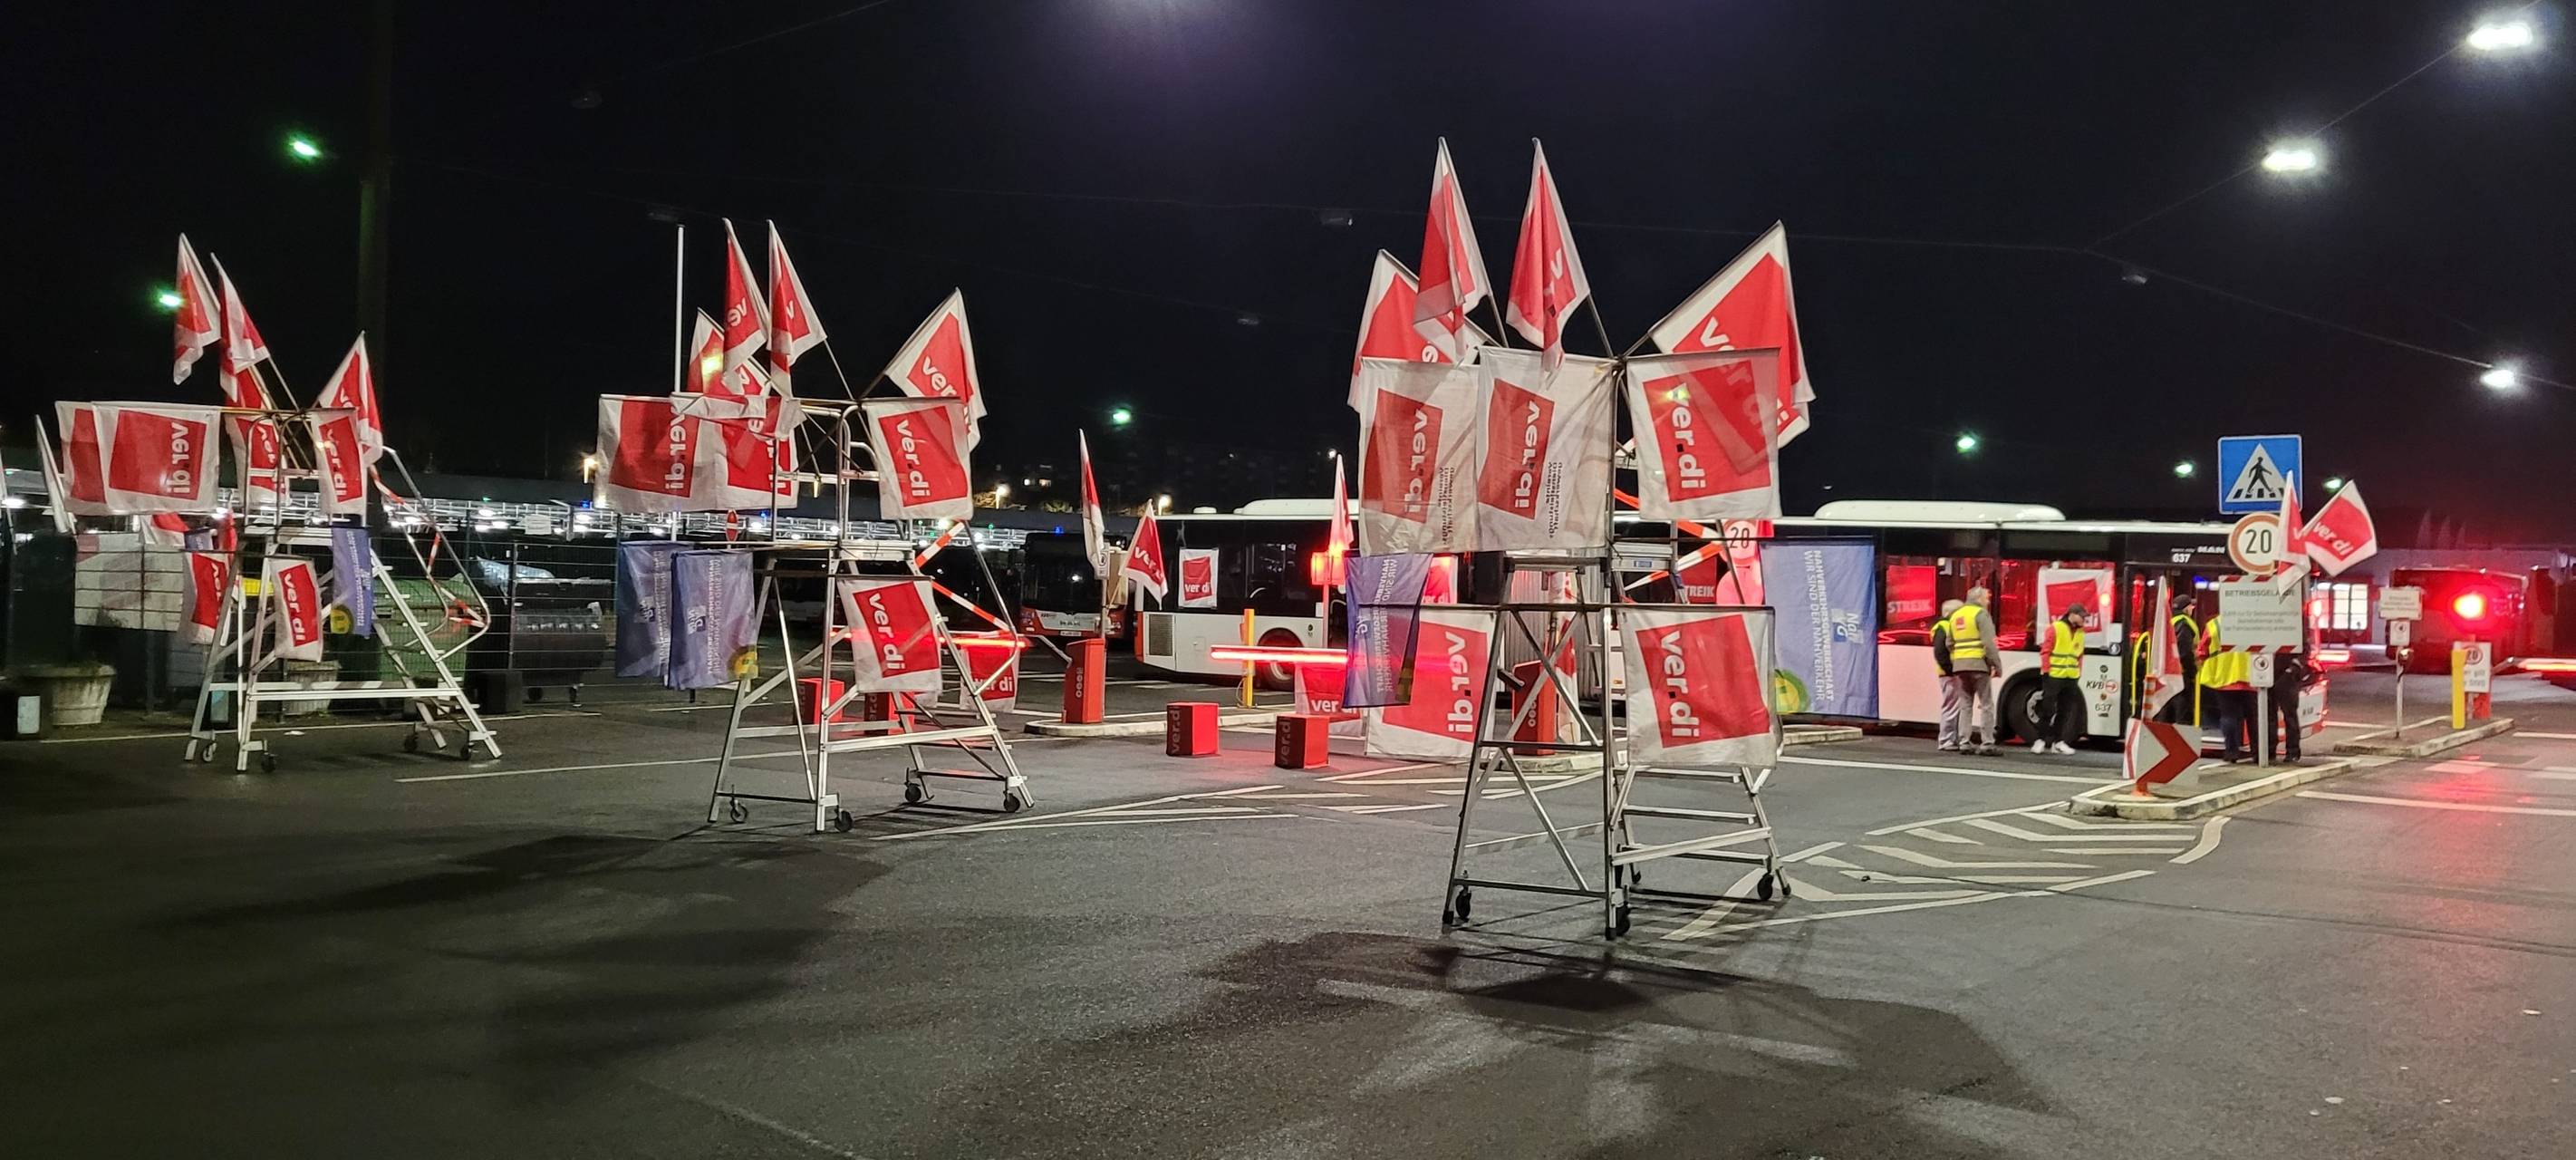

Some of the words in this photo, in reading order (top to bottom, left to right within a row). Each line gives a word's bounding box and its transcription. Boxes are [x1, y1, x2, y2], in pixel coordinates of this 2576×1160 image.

[1730, 527, 1749, 550] 20
[2244, 529, 2272, 555] 20
[2171, 554, 2191, 564] 637
[1660, 630, 1701, 739] ver.di
[2086, 680, 2105, 691] KVB
